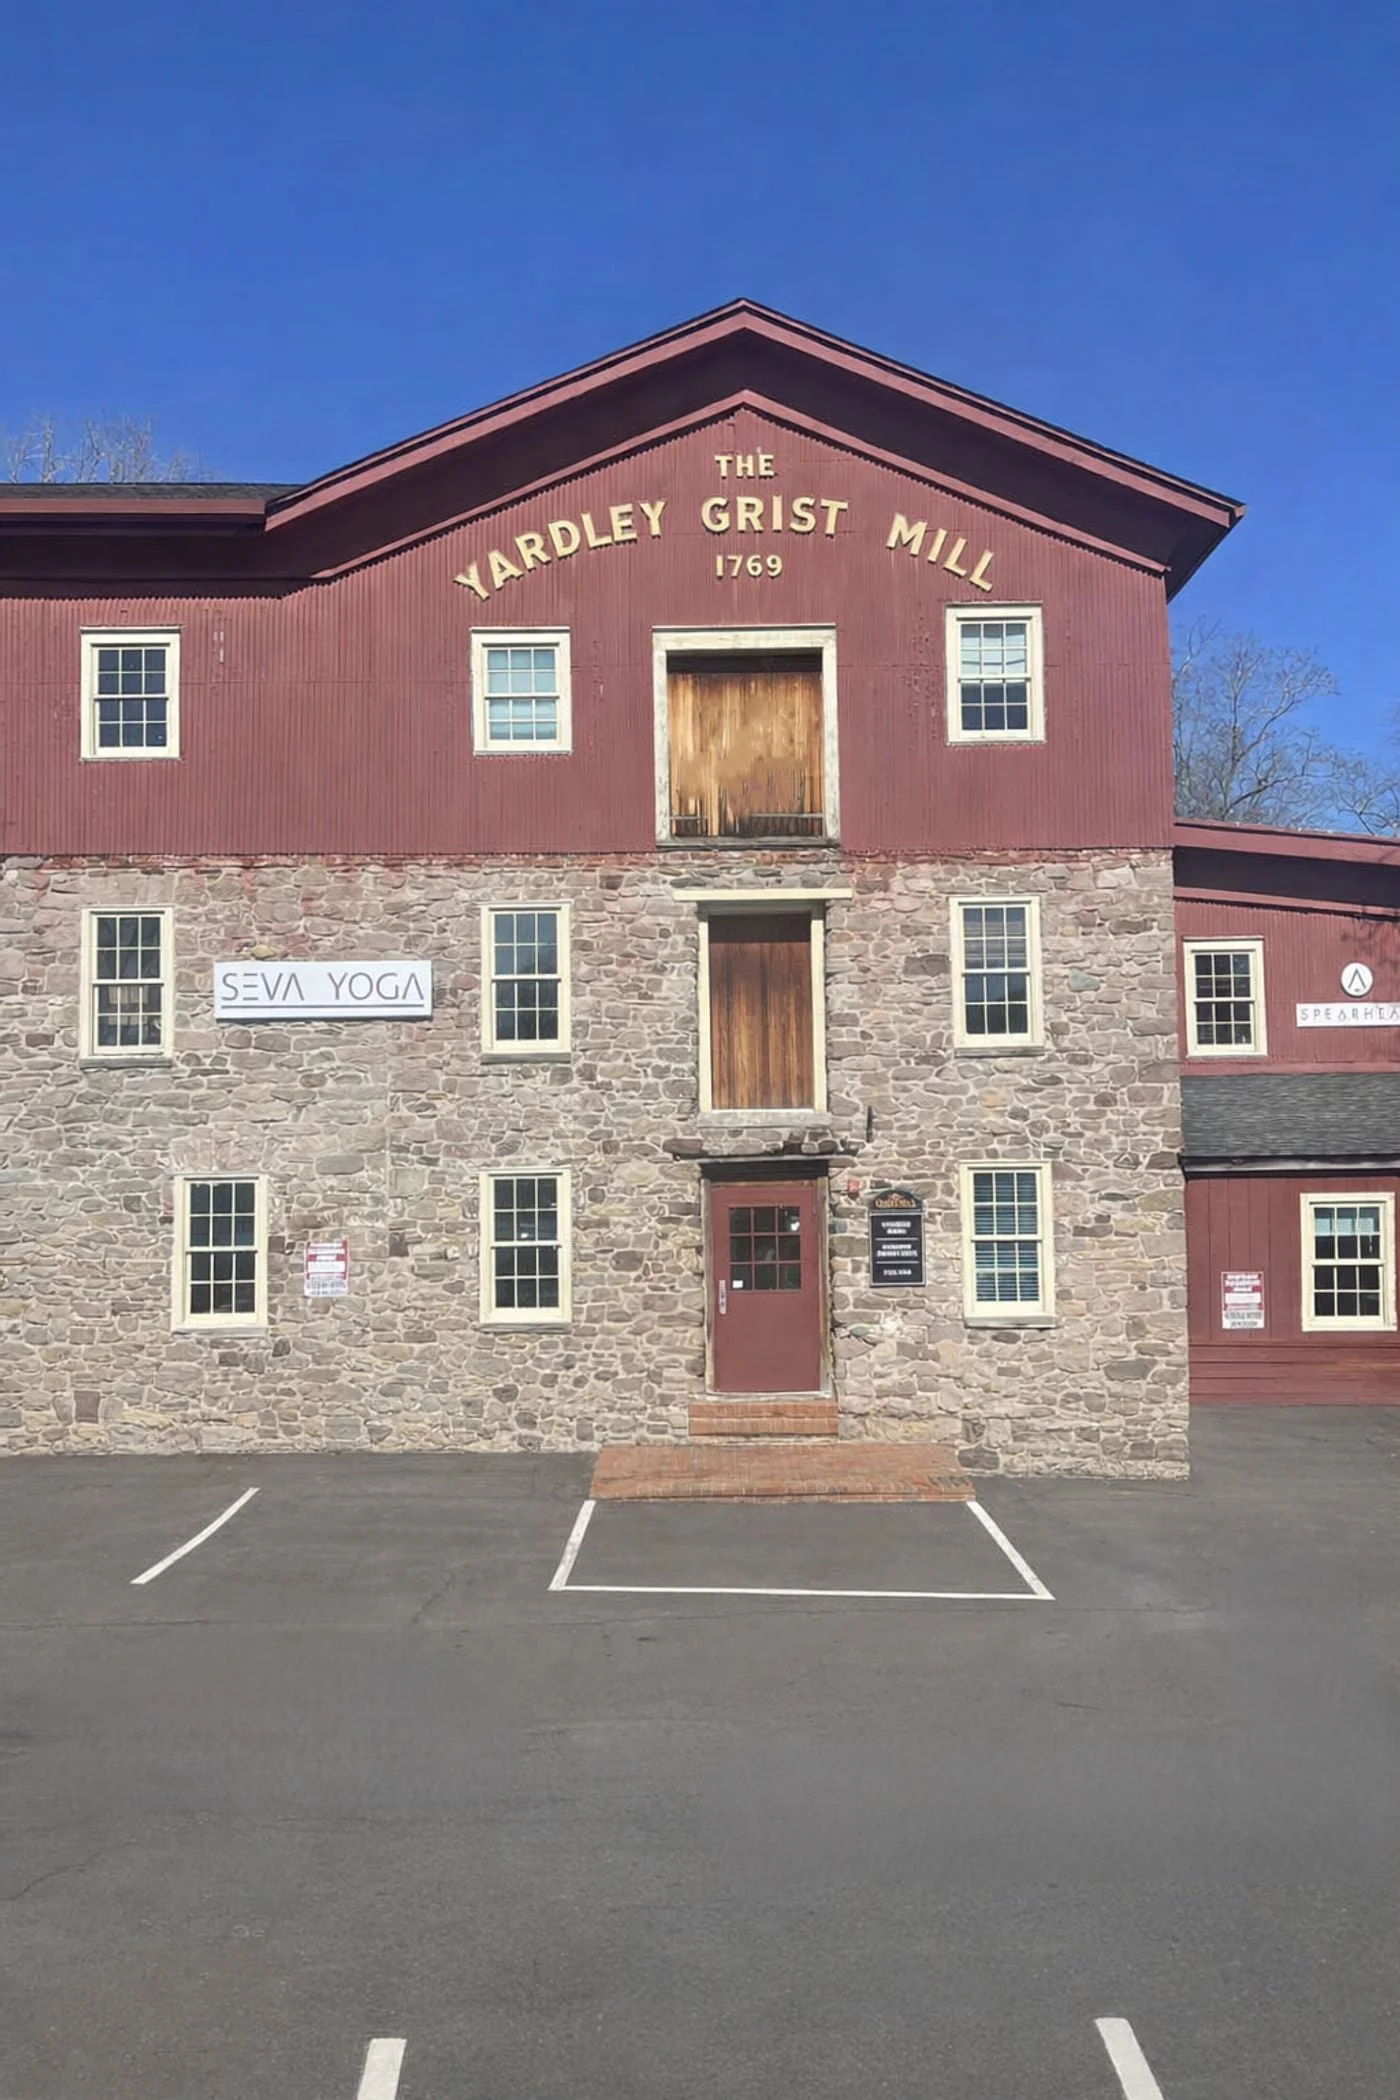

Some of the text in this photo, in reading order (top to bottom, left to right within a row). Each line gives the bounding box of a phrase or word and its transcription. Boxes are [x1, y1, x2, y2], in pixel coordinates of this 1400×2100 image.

[714, 454, 775, 477] THE
[454, 496, 995, 600] YARDLEY GRIST MILL
[716, 555, 784, 578] 1769
[221, 972, 424, 1001] SEVA YOGA
